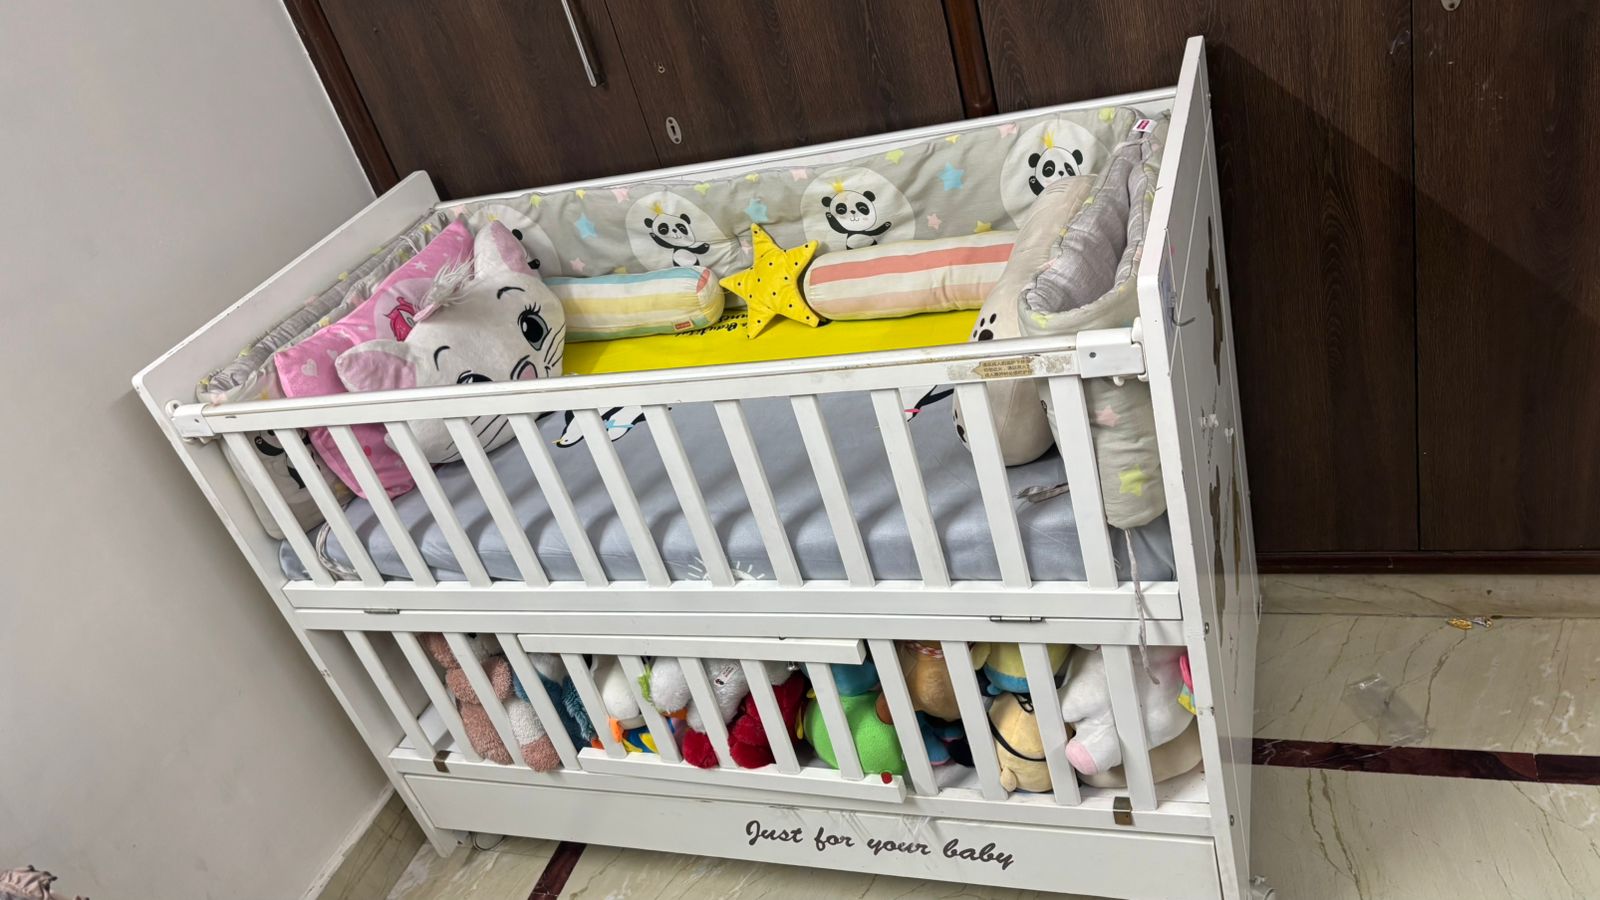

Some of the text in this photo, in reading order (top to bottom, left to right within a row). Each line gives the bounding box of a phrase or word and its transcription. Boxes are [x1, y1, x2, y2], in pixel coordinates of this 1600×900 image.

[745, 820, 1014, 871] Just for your baby
